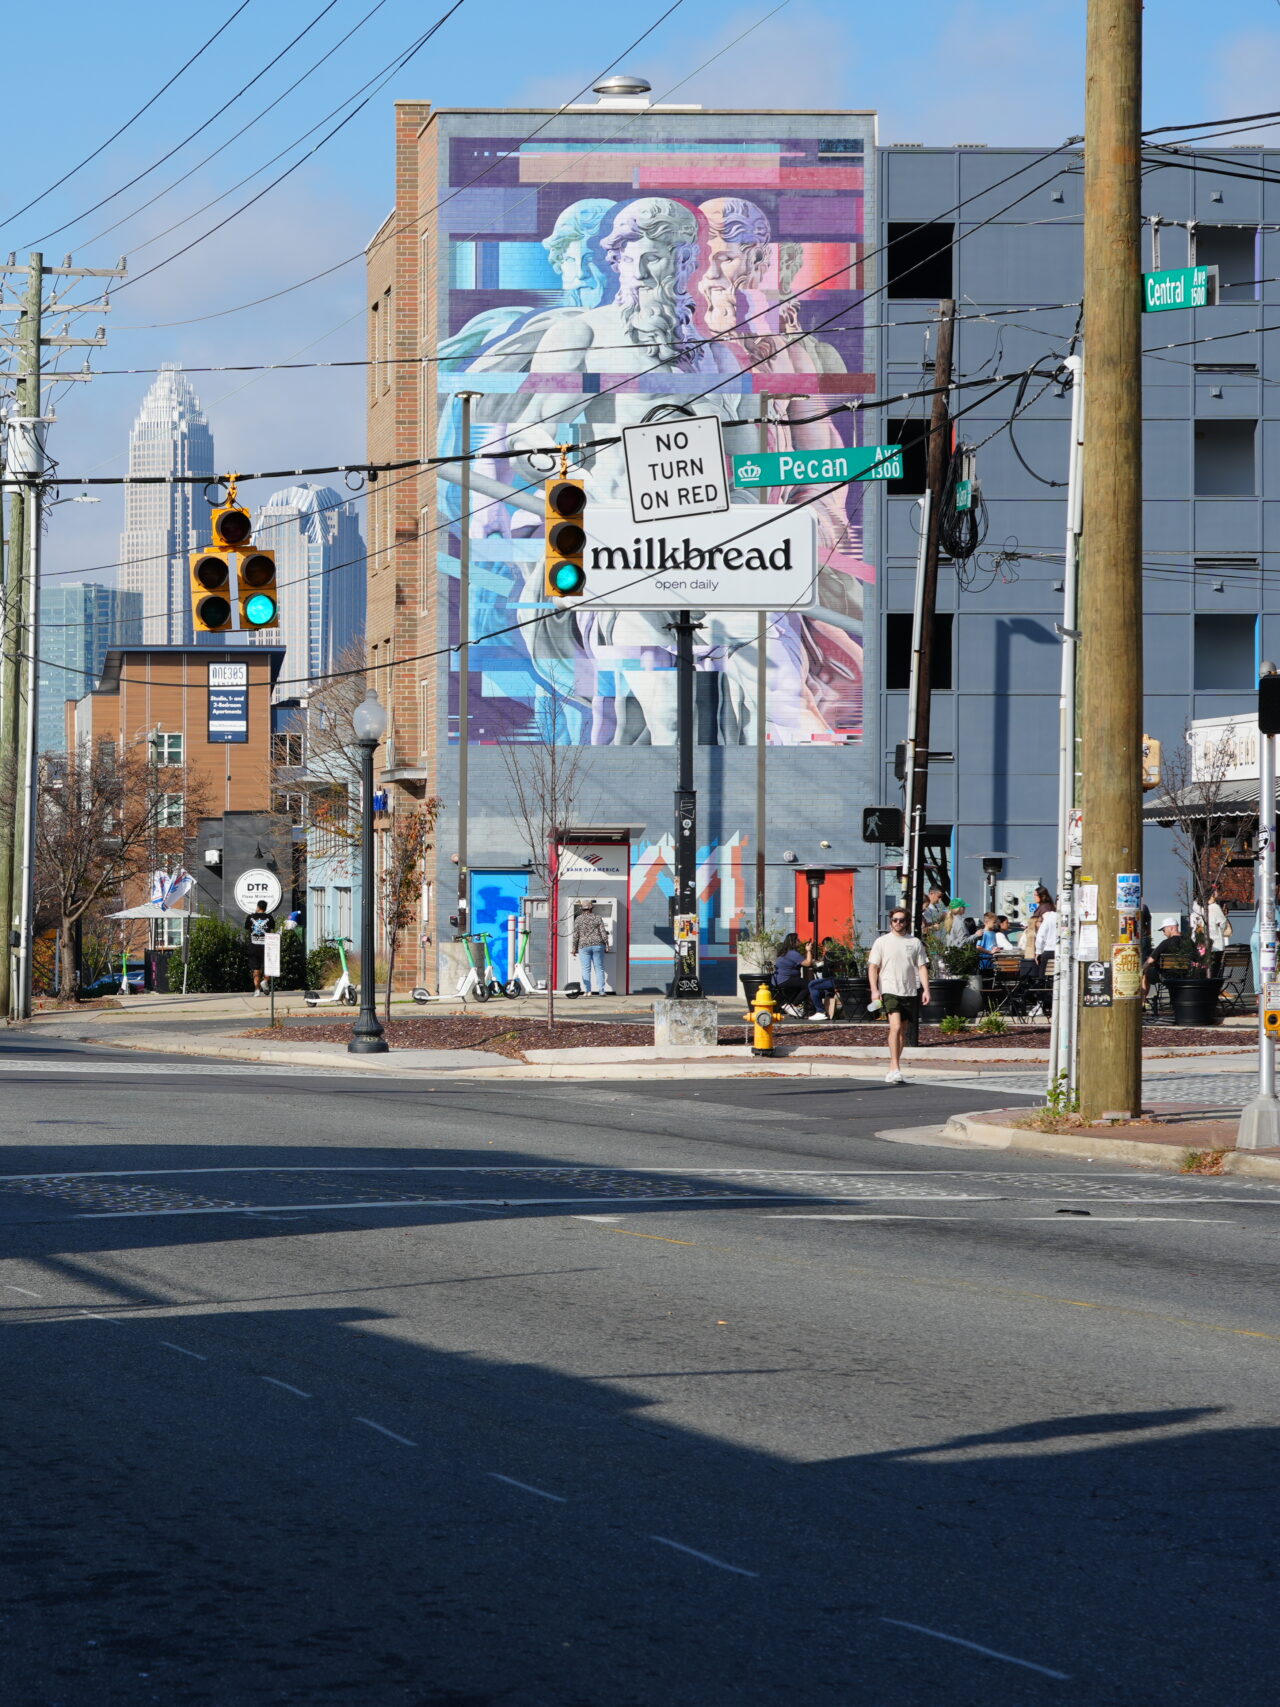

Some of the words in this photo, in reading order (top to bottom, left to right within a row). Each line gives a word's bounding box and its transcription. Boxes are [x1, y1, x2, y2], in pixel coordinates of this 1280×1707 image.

[1193, 268, 1206, 286] Ave
[1147, 275, 1184, 306] Central
[1190, 287, 1205, 306] 1500
[656, 432, 688, 452] NO
[875, 446, 899, 462] Ave
[648, 457, 703, 481] TURN
[779, 456, 848, 480] Pecan
[870, 461, 900, 478] 1300
[641, 490, 668, 510] ON
[678, 484, 717, 505] RED
[591, 537, 793, 571] milkbread
[655, 581, 687, 592] open
[689, 579, 719, 593] daily
[247, 883, 269, 891] DTR
[1115, 962, 1140, 972] STUFF
[1121, 954, 1137, 963] HOT
